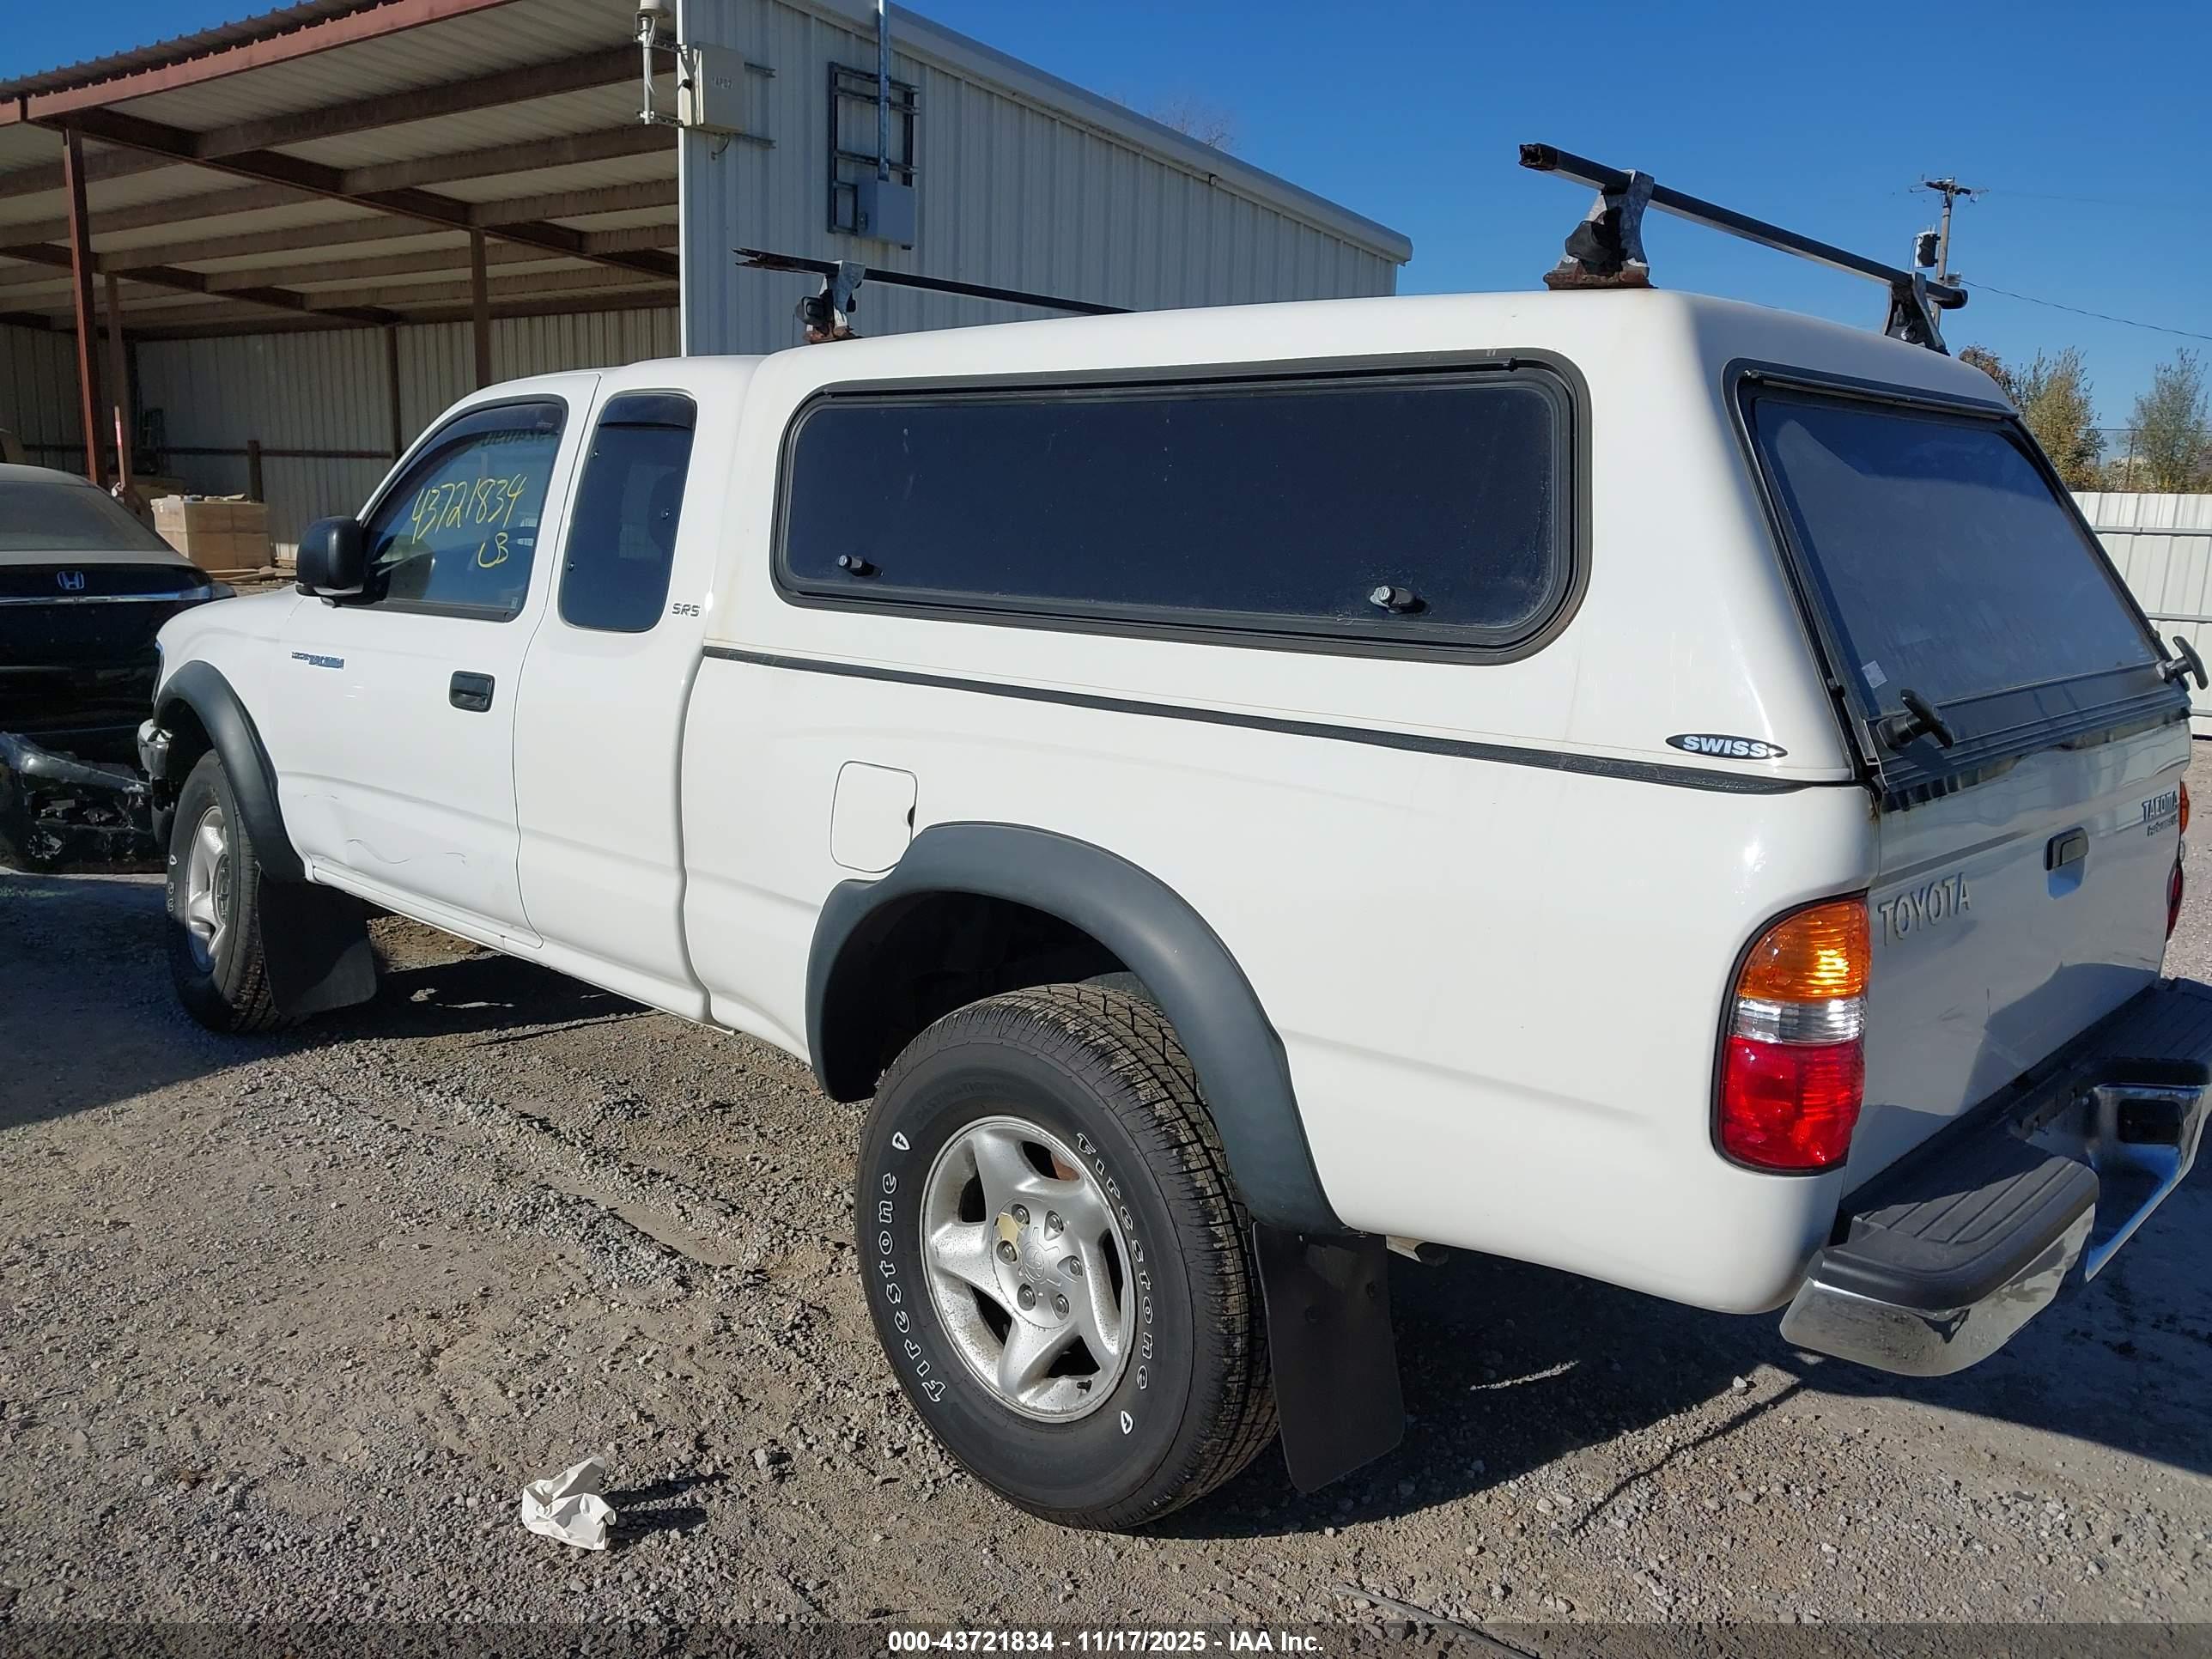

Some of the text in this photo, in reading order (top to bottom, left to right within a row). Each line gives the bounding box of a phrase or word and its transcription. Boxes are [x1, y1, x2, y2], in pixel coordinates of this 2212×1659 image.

[411, 473, 527, 545] 43721834
[1683, 735, 1770, 758] SWISS
[1877, 872, 1970, 946] TOYOTA
[878, 1172, 946, 1402] Firestone
[1077, 1133, 1154, 1390] Firestone
